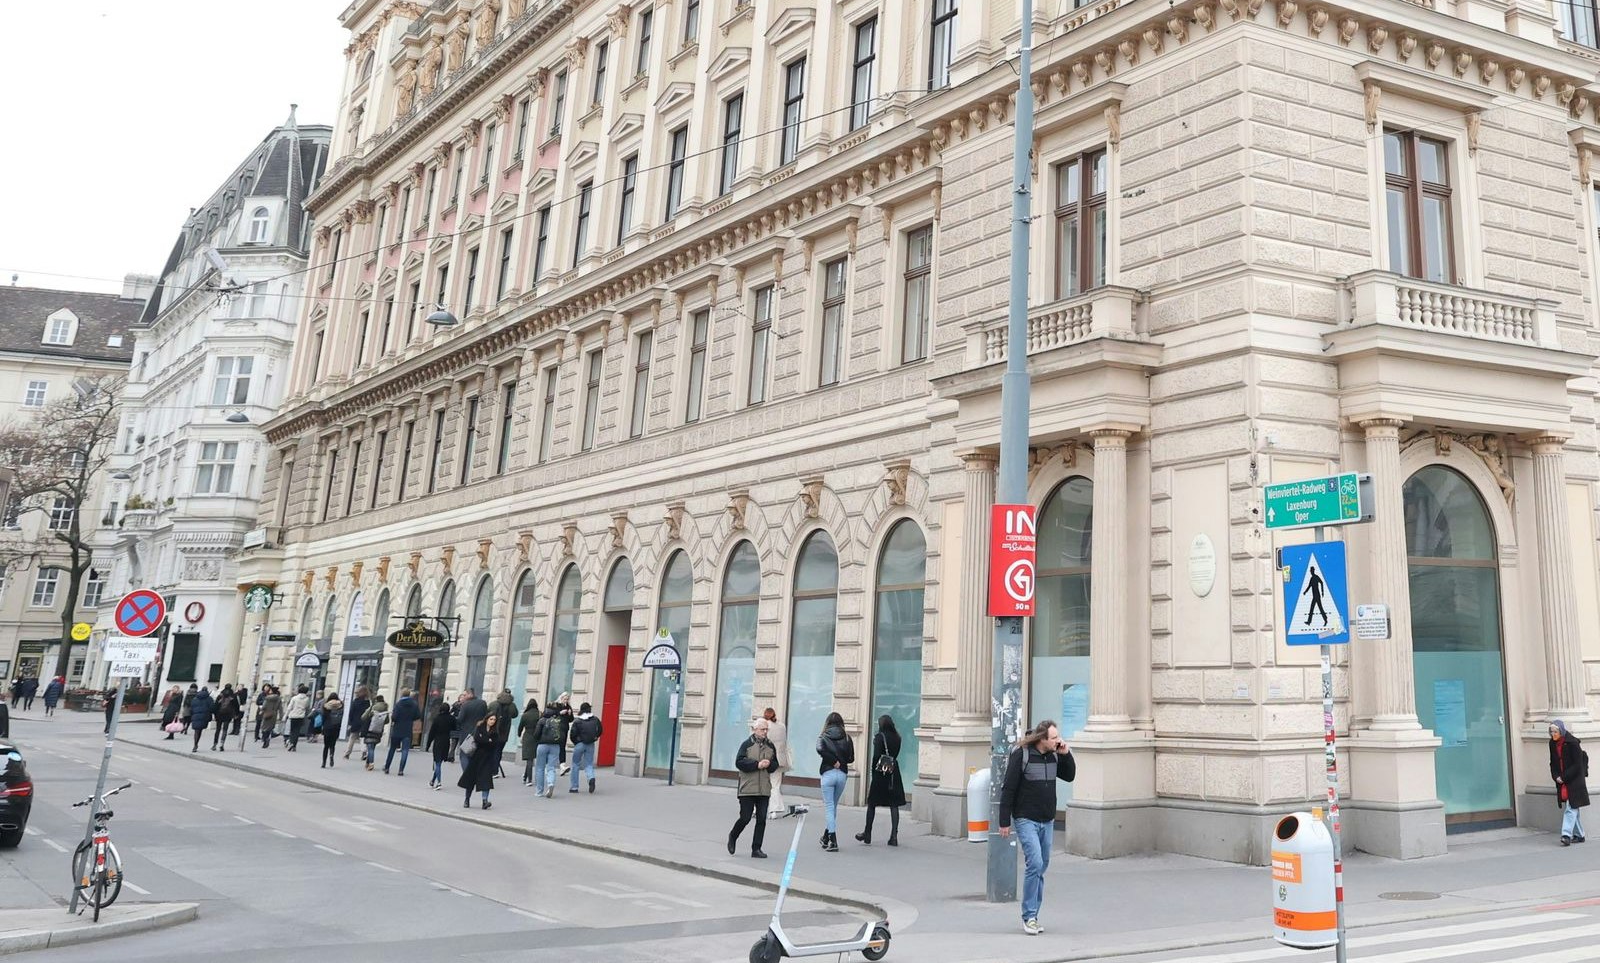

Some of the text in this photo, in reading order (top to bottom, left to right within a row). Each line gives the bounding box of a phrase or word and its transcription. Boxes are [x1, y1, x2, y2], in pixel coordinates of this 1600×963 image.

[1266, 482, 1327, 500] Weinviertel-Radweg
[1286, 499, 1318, 511] Laxenburg
[1295, 511, 1309, 522] Oper
[123, 650, 140, 658] Taxi
